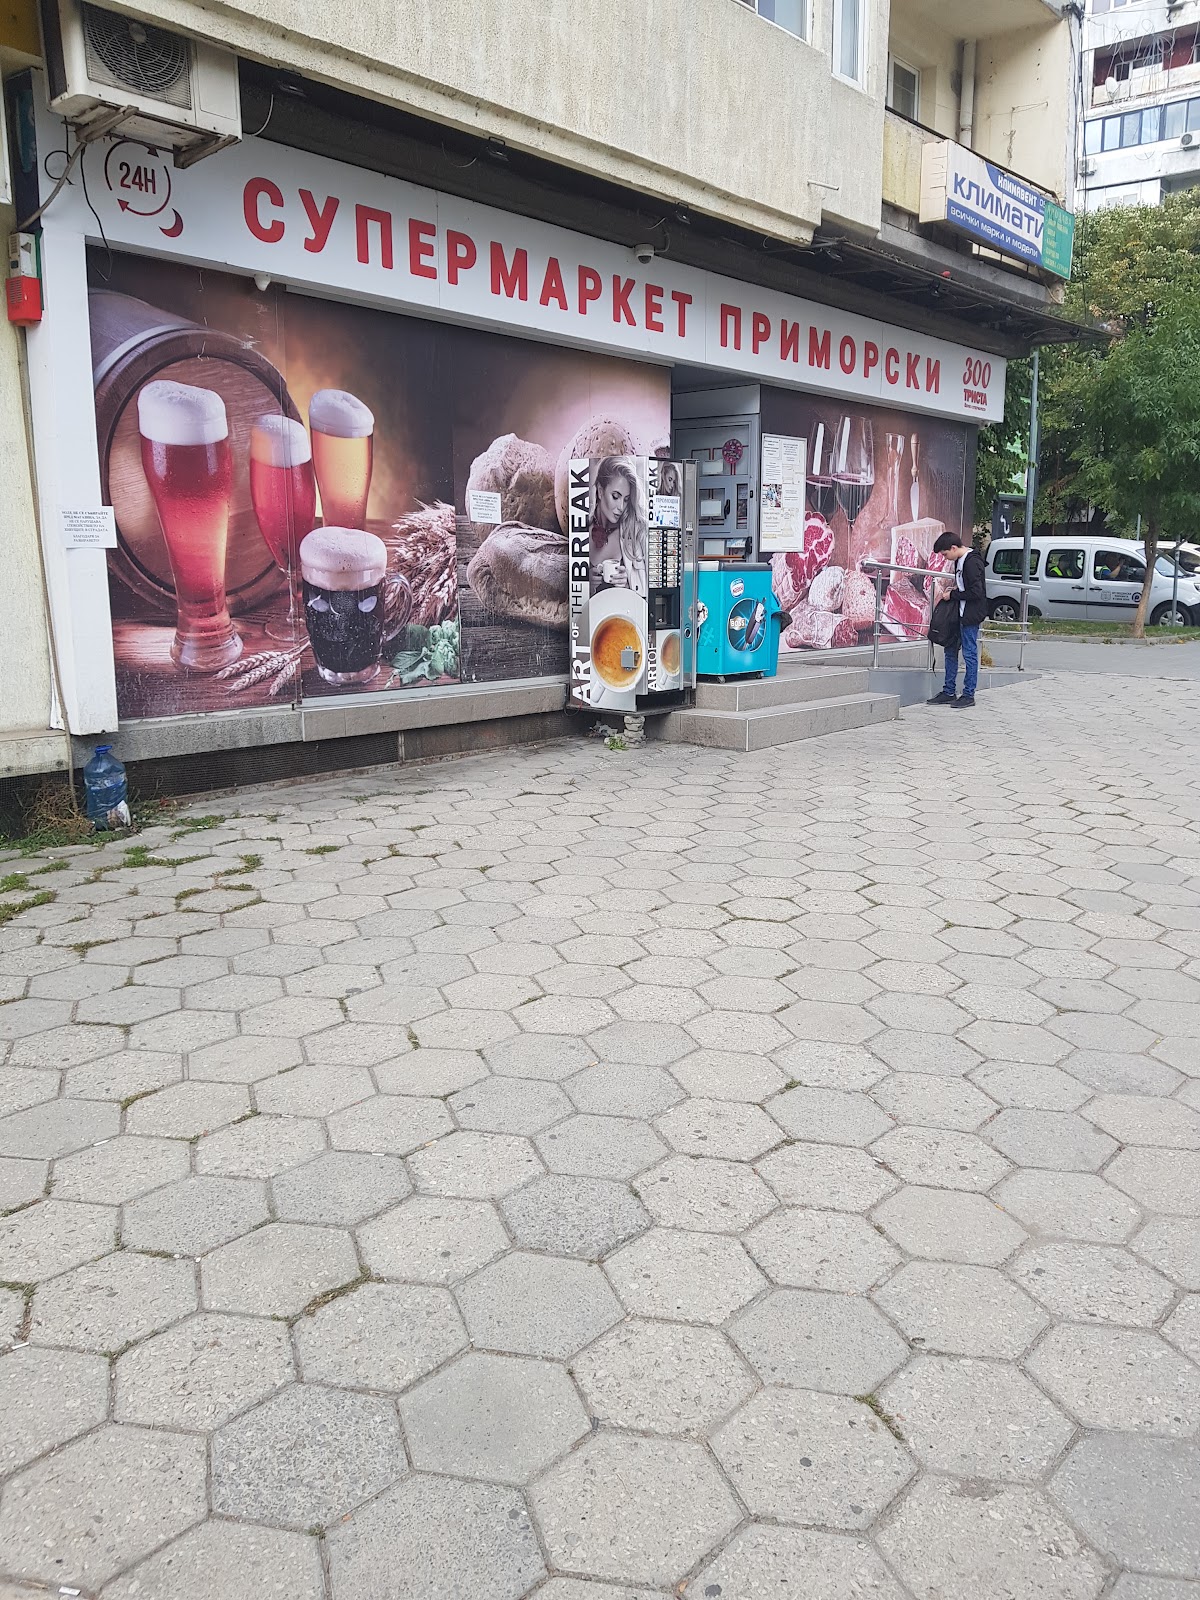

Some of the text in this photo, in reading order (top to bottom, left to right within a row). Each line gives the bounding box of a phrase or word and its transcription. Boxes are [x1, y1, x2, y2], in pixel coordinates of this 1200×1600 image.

[119, 161, 156, 194] 24H
[950, 206, 980, 226] всички
[981, 221, 1005, 239] марки
[1005, 233, 1011, 243] и
[1011, 239, 1038, 258] модели
[243, 176, 941, 394] СУПЕРМАРКЕТ ПРИМОРСКИ
[962, 356, 992, 389] 300
[963, 388, 988, 406] ТРИСТА
[570, 464, 591, 706] ART OF THE BREAK
